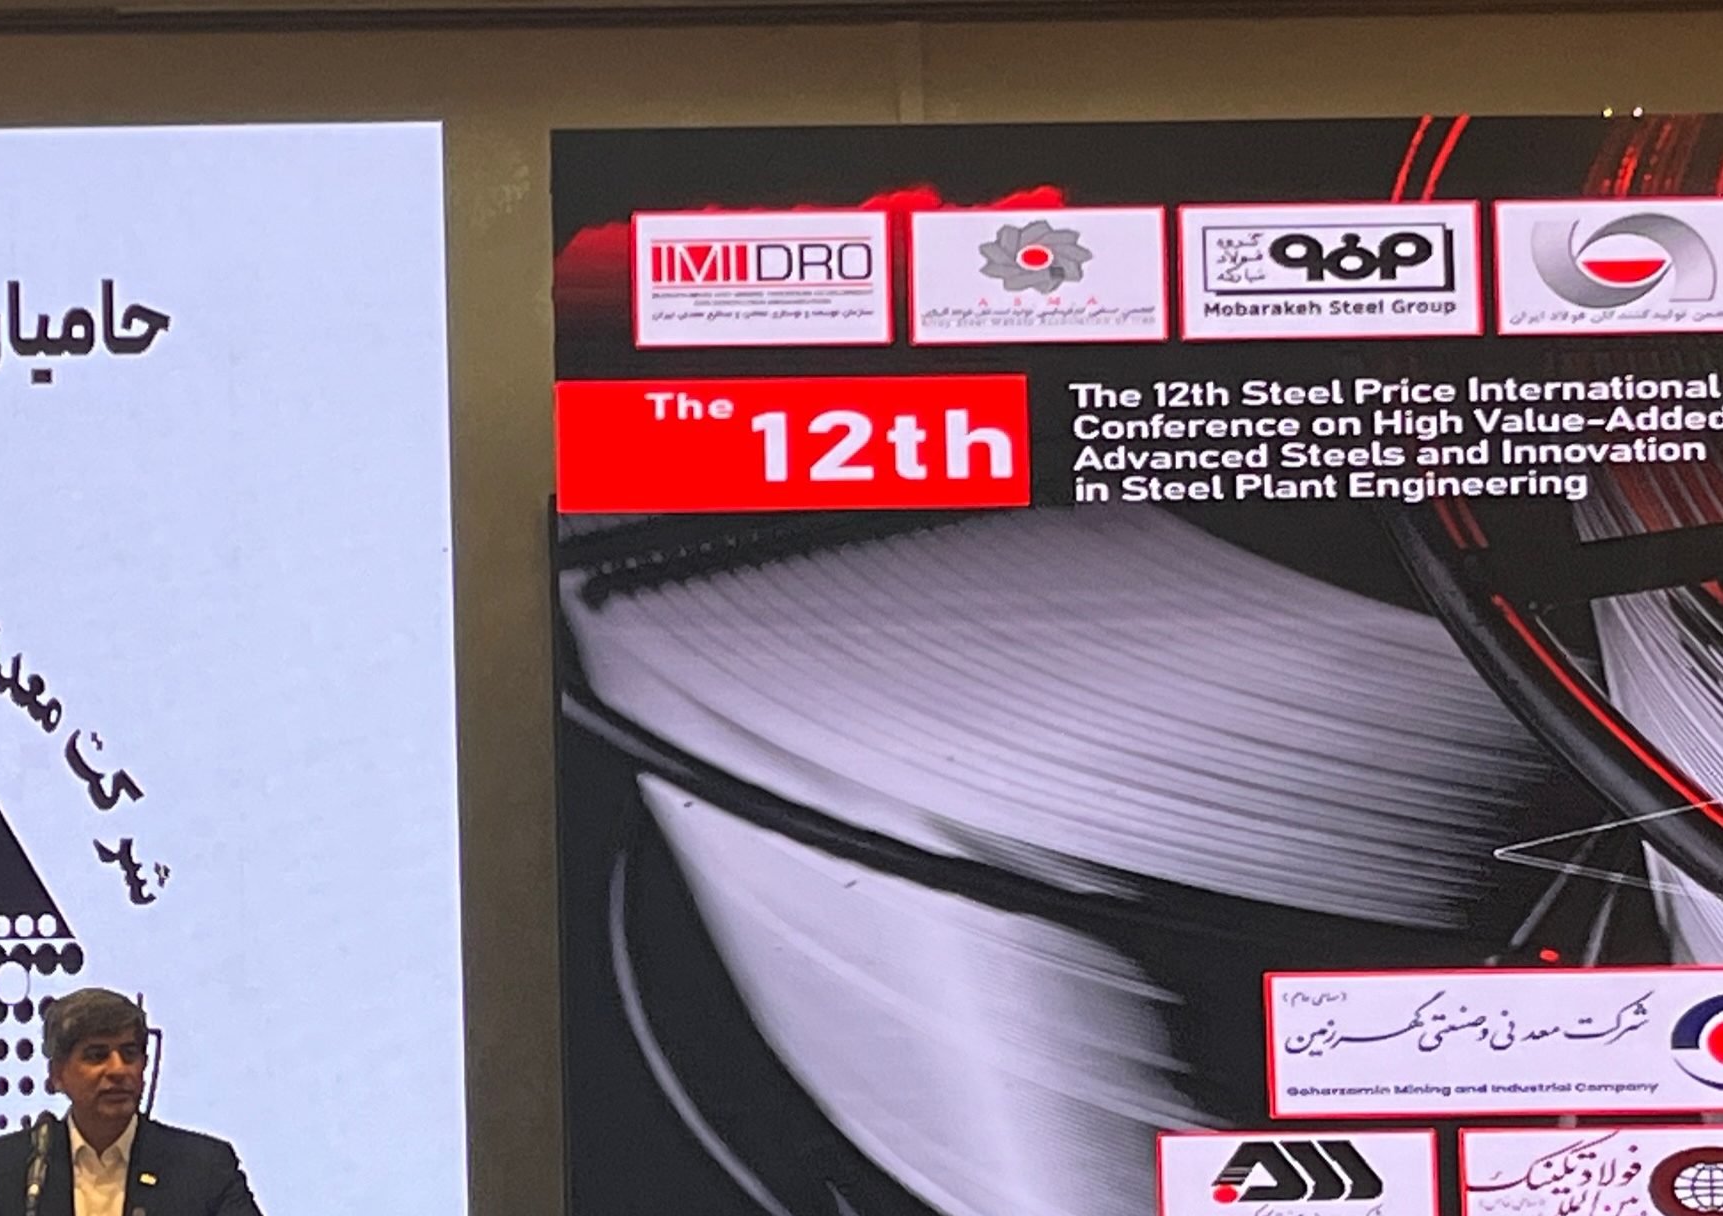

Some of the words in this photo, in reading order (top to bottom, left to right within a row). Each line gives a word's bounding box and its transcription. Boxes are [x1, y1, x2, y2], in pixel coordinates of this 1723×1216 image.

[650, 242, 874, 284] IMIDRO
[1204, 301, 1322, 317] Mobarakeh
[1329, 300, 1384, 316] Steel
[1391, 299, 1457, 316] Group
[1069, 383, 1142, 408] The
[1153, 382, 1229, 407] 12th
[1241, 380, 1344, 405] Steel
[1354, 379, 1456, 403] Price
[1468, 375, 1722, 402] International
[645, 391, 735, 420] The
[750, 408, 1014, 483] 12th
[1074, 413, 1300, 440] Conference
[1311, 416, 1362, 438] on
[1374, 409, 1464, 442] High
[1073, 444, 1269, 471] Advanced
[1280, 441, 1406, 468] Steels
[1416, 440, 1489, 467] and
[1501, 437, 1708, 465] Innovation
[1075, 476, 1109, 502] in
[1121, 474, 1223, 502] Steel
[1234, 473, 1338, 501] Plant
[1348, 471, 1590, 504] Engineering
[1416, 1005, 1487, 1053] صنعتی
[1562, 989, 1655, 1047] شرکت
[1454, 1083, 1489, 1096] and
